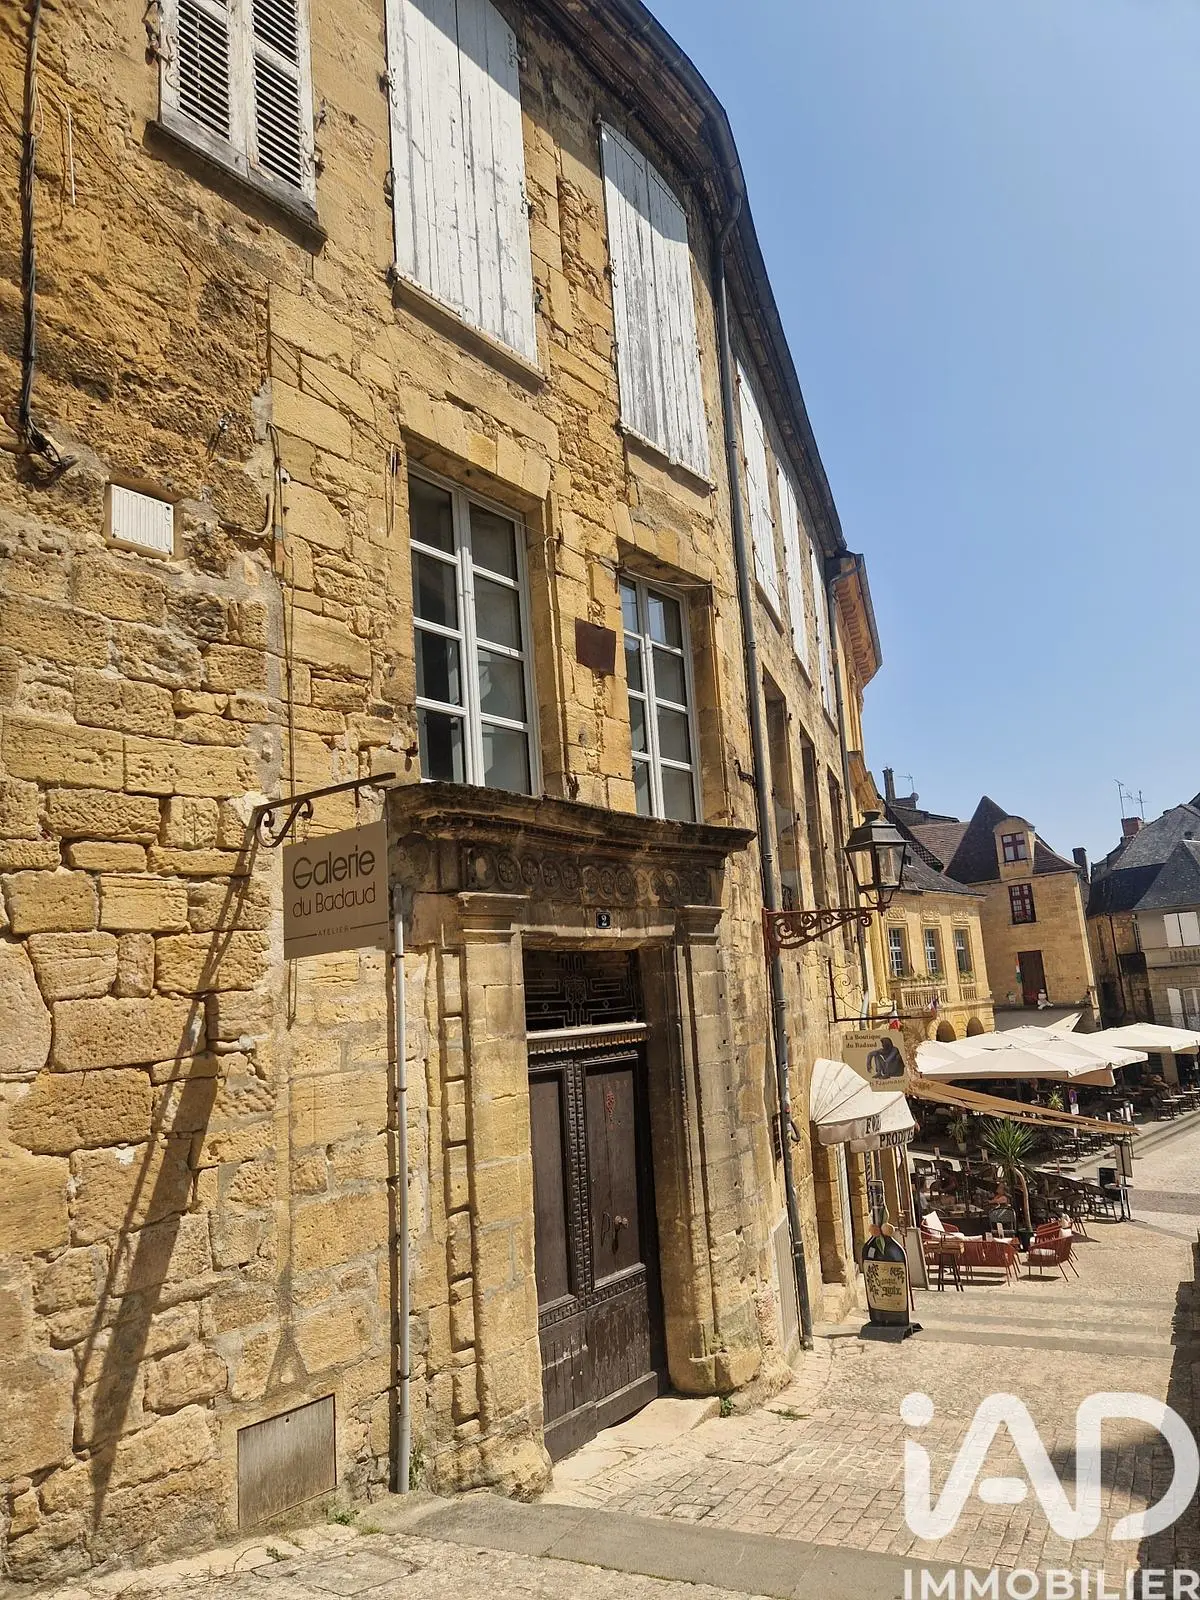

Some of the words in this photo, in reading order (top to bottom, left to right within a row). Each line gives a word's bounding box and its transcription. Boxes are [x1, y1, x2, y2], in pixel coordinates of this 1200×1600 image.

[293, 844, 375, 889] Galerie
[293, 896, 311, 917] du
[315, 881, 376, 913] Badaud
[318, 925, 350, 936] ATELIER
[855, 1033, 881, 1041] Boutique
